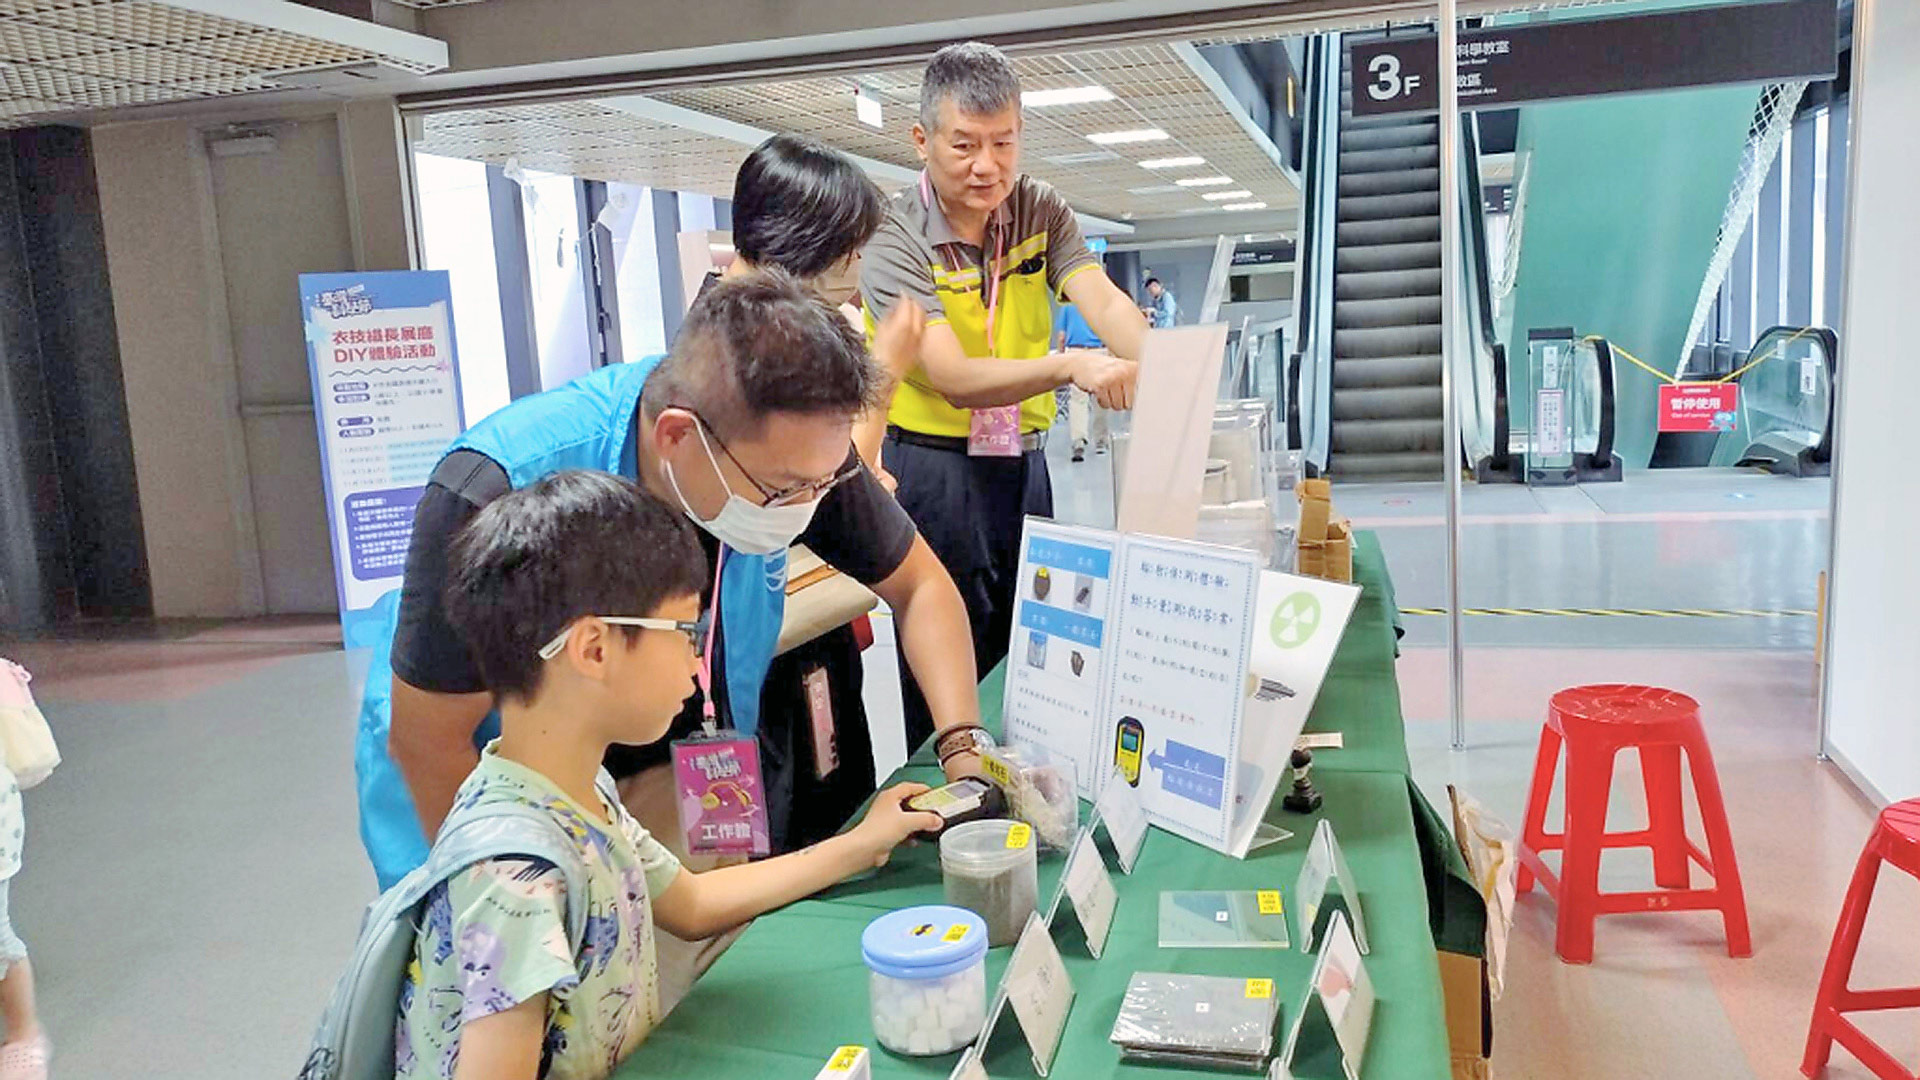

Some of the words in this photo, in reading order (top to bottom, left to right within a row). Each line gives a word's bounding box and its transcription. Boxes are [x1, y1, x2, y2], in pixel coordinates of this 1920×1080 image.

[1367, 54, 1421, 101] 3F
[1671, 397, 1721, 410] 暫停使用
[701, 822, 752, 840] 工作證
